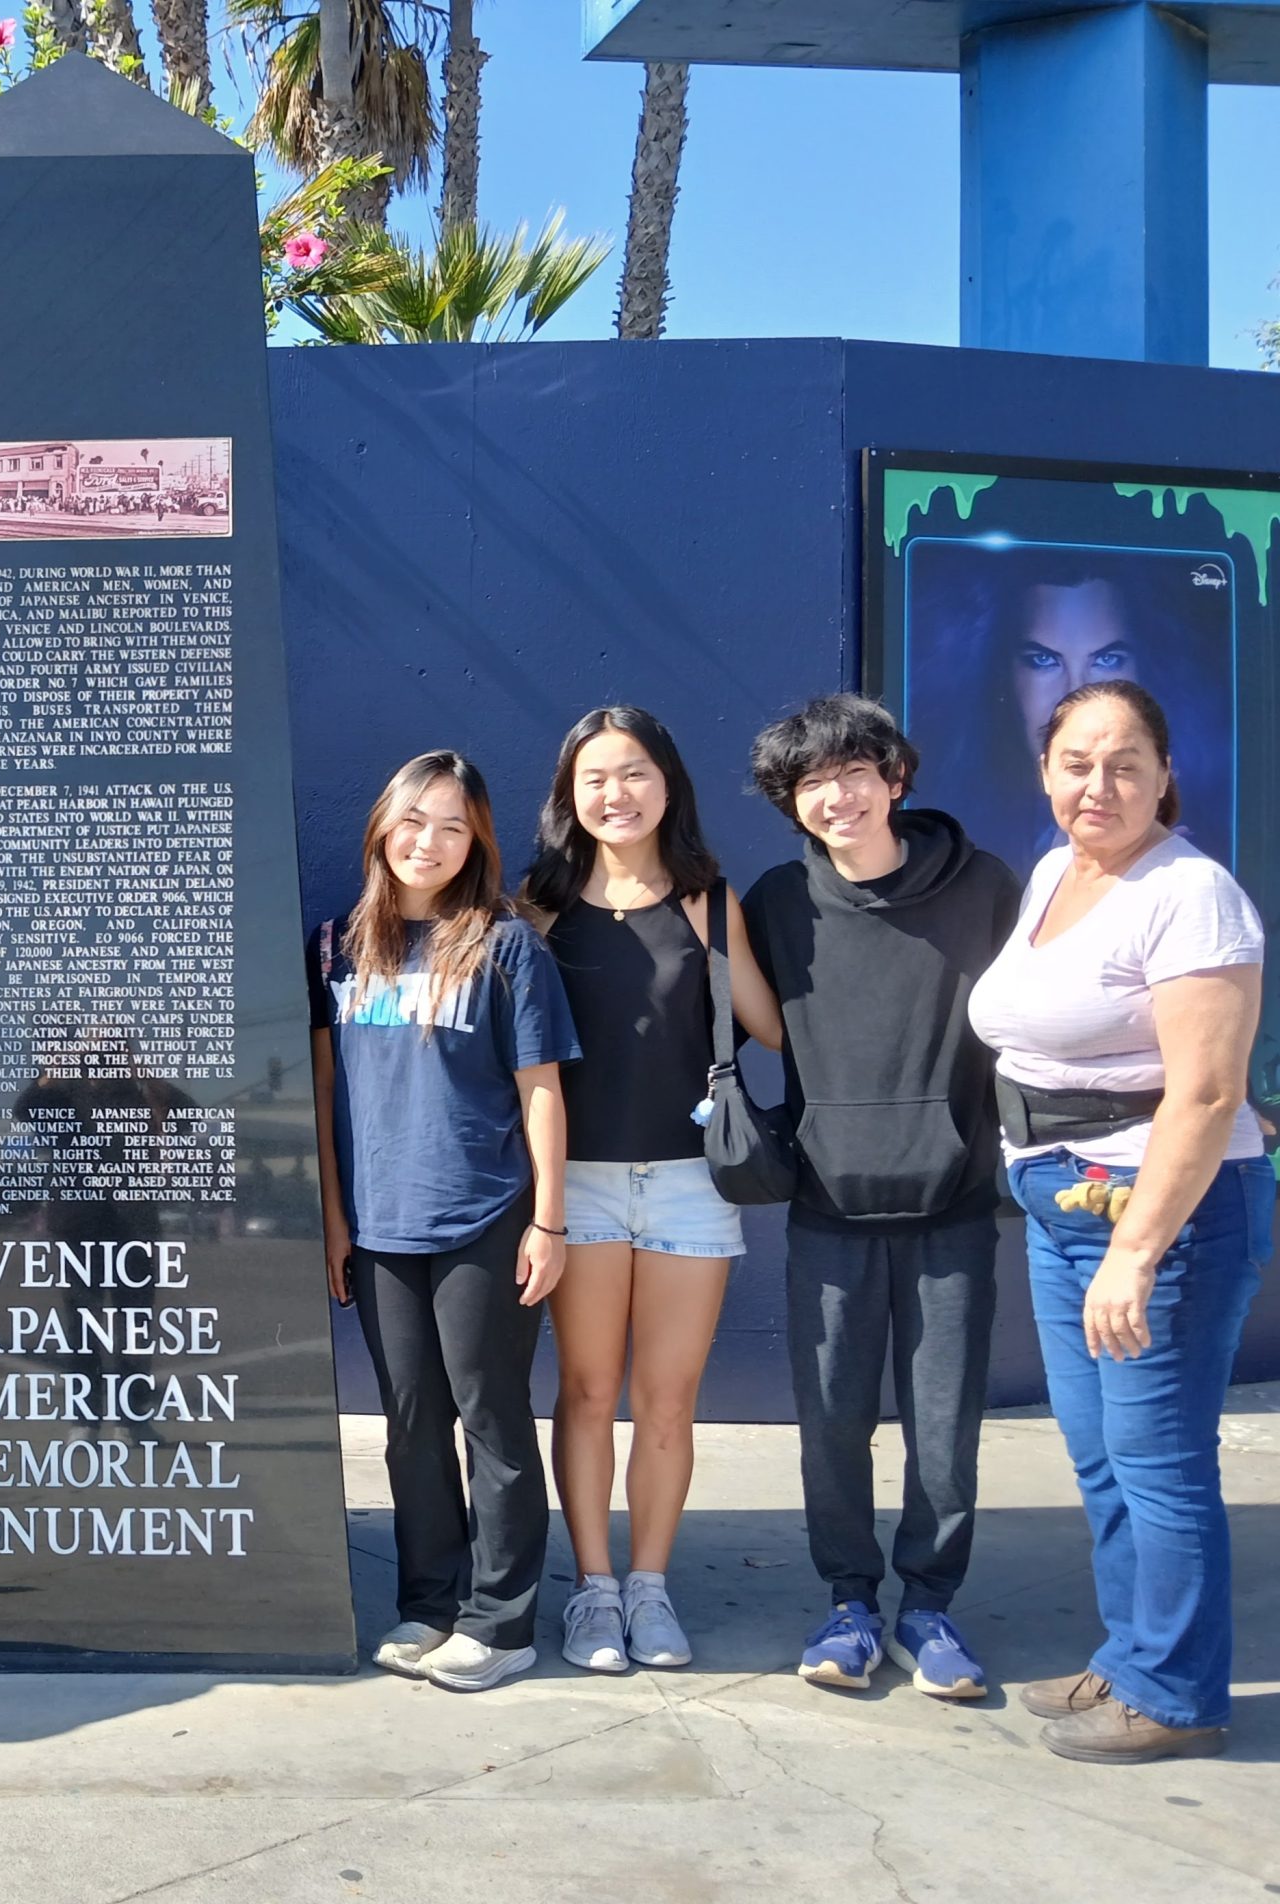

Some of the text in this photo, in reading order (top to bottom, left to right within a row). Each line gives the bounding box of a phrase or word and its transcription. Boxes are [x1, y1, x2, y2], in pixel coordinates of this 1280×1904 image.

[20, 567, 66, 578] DURING
[70, 566, 112, 577] WORLD
[115, 566, 140, 576] WAR
[144, 566, 156, 577] II,
[160, 565, 192, 576] MORE
[196, 565, 231, 575] THAN
[24, 581, 89, 591] AMERICAN
[103, 580, 134, 590] MEN,
[144, 579, 192, 590] WOMEN,
[204, 578, 232, 588] AND
[20, 595, 80, 605] JAPANESE
[87, 594, 150, 604] ANCESTRY
[160, 593, 173, 603] IN
[183, 593, 232, 603] VENICE,
[27, 609, 54, 619] AND
[59, 608, 107, 619] MALIBU
[113, 607, 177, 618] REPORTED
[182, 606, 198, 617] TO
[203, 606, 232, 616] THIS
[5, 624, 50, 634] VENICE
[58, 623, 84, 633] AND
[91, 622, 143, 633] LINCOLN
[150, 621, 232, 632] BOULEVARDS.
[2, 637, 61, 648] ALLOWED
[64, 636, 80, 647] TO
[83, 636, 121, 647] BRING
[125, 636, 157, 646] WITH
[161, 635, 197, 645] THEM
[200, 634, 232, 644] ONLY
[2, 651, 43, 661] COULD
[91, 650, 115, 660] THE
[119, 649, 176, 659] WESTERN
[181, 648, 232, 658] DEFENSE
[31, 664, 78, 674] FOURTH
[84, 663, 121, 673] ARMY
[128, 662, 169, 673] ISSUED
[175, 662, 232, 672] CIVILIAN
[0, 678, 40, 689] ORDER
[72, 677, 77, 686] 7
[86, 677, 127, 687] WHICH
[135, 676, 167, 686] GAVE
[175, 675, 232, 685] FAMILIES
[1, 692, 17, 702] TO
[24, 691, 71, 701] DISPOSE
[78, 690, 92, 701] OF
[99, 690, 135, 700] THEIR
[142, 689, 199, 700] PROPERTY
[205, 688, 233, 699] AND
[33, 704, 72, 715] BUSES
[84, 703, 180, 714] TRANSPORTED
[194, 702, 232, 712] THEM
[19, 718, 44, 728] THE
[53, 718, 119, 728] AMERICAN
[126, 716, 232, 726] CONCENTRATION
[70, 732, 83, 741] IN
[91, 731, 121, 741] INYO
[127, 730, 179, 740] COUNTY
[187, 729, 232, 739] WHERE
[41, 745, 76, 755] WERE
[80, 744, 172, 754] INCARCERATED
[175, 743, 197, 753] FOR
[200, 742, 232, 753] MORE
[14, 758, 56, 769] YEARS.
[31, 920, 86, 930] OREGON,
[106, 919, 135, 929] AND
[153, 919, 233, 929] CALIFORNIA
[16, 947, 52, 957] 120,000
[62, 946, 121, 956] JAPANESE
[131, 945, 158, 956] AND
[167, 945, 234, 956] AMERICAN
[33, 1014, 135, 1024] CONCENTRATION
[142, 1013, 183, 1023] CAMPS
[190, 1013, 234, 1023] UNDER
[32, 1041, 128, 1051] IMPRISONMENT,
[139, 1040, 197, 1050] WITHOUT
[206, 1040, 234, 1050] ANY
[29, 1108, 75, 1119] VENICE
[91, 1108, 151, 1118] JAPANESE
[167, 1108, 234, 1119] AMERICAN
[53, 1149, 102, 1159] RIGHTS.
[123, 1149, 149, 1159] THE
[160, 1149, 211, 1159] POWERS
[221, 1149, 236, 1160] OF
